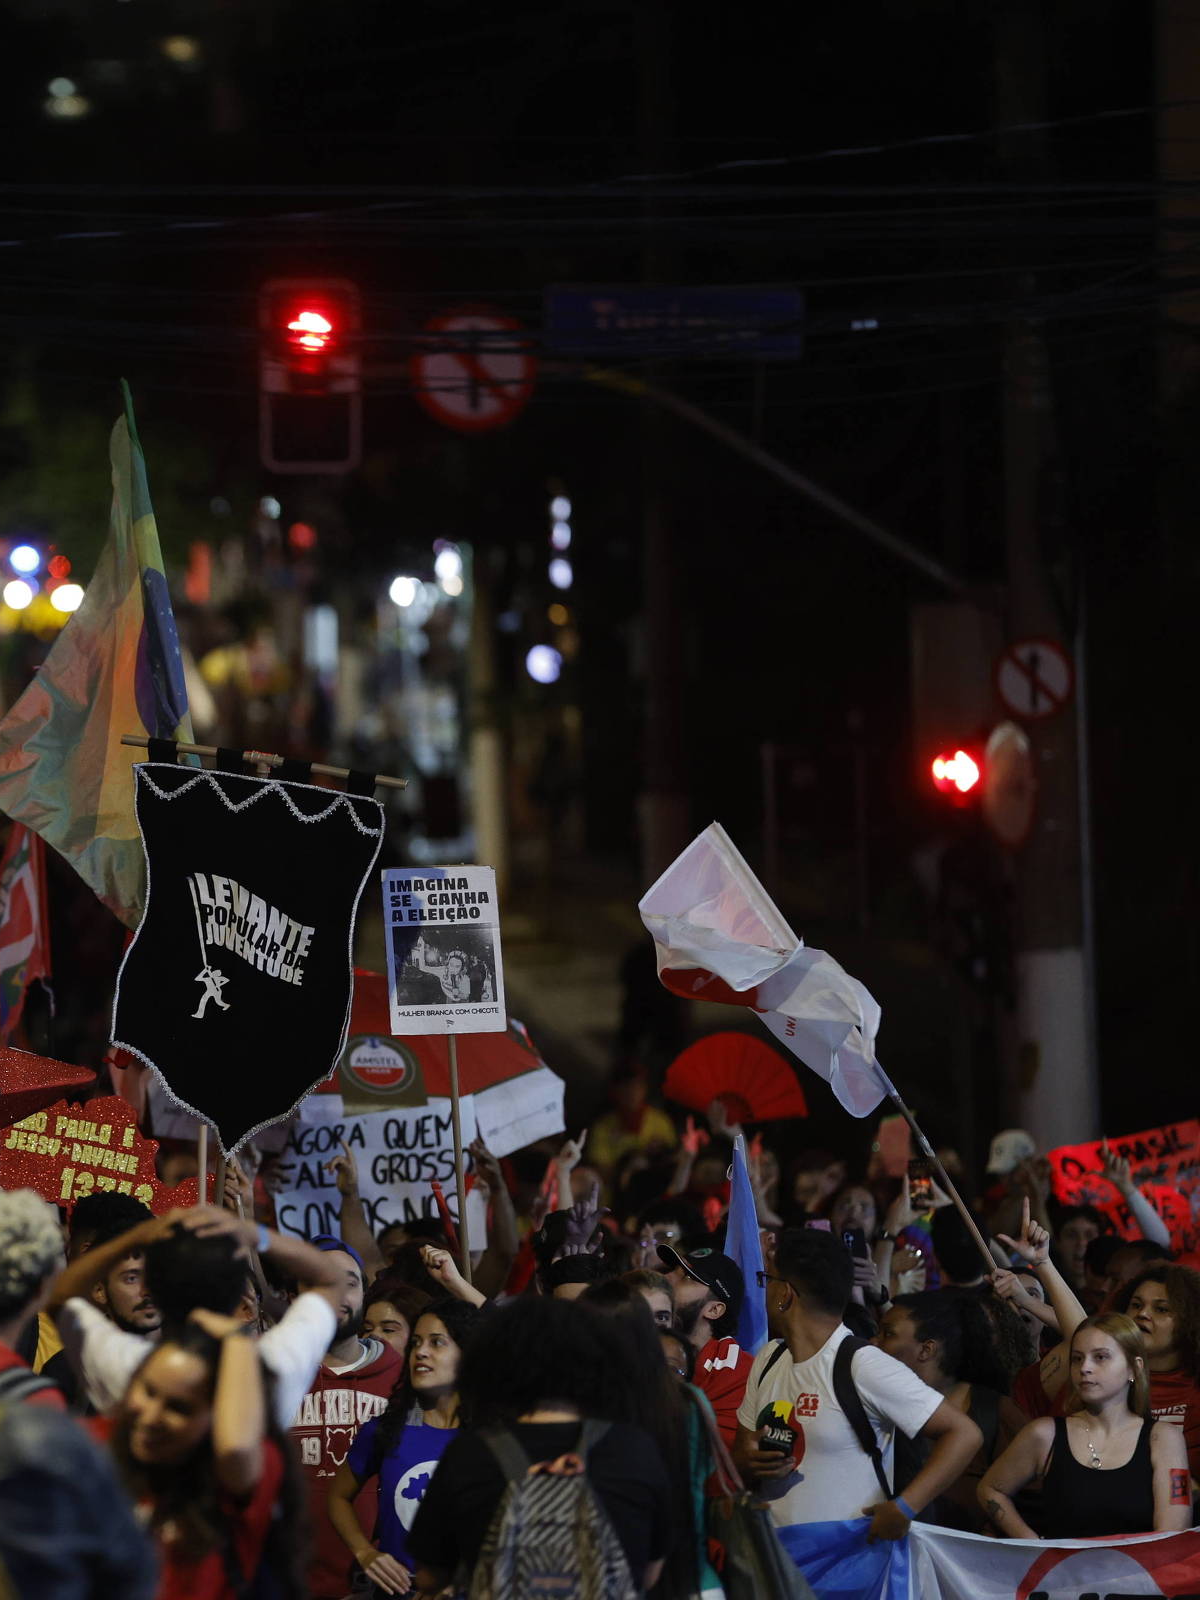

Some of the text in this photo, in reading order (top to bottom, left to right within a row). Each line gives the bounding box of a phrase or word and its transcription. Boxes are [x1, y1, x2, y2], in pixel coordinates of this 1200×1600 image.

[390, 878, 469, 893] IMAGINA
[390, 891, 490, 908] SE GANHA
[194, 872, 316, 958] LEVANTE
[392, 903, 481, 923] A ELEIÇÃO
[201, 903, 280, 960] POPULAR
[205, 922, 305, 987] JUVENTUDE
[427, 1009, 454, 1017] BRANCA
[455, 1008, 471, 1016] COM
[471, 1006, 499, 1015] CHICOTE
[55, 1115, 112, 1145] PAULO
[121, 1123, 136, 1149] É
[284, 1121, 365, 1156] AGORA
[4, 1129, 139, 1175] JESSY DAYANE
[767, 1427, 794, 1443] UNE
